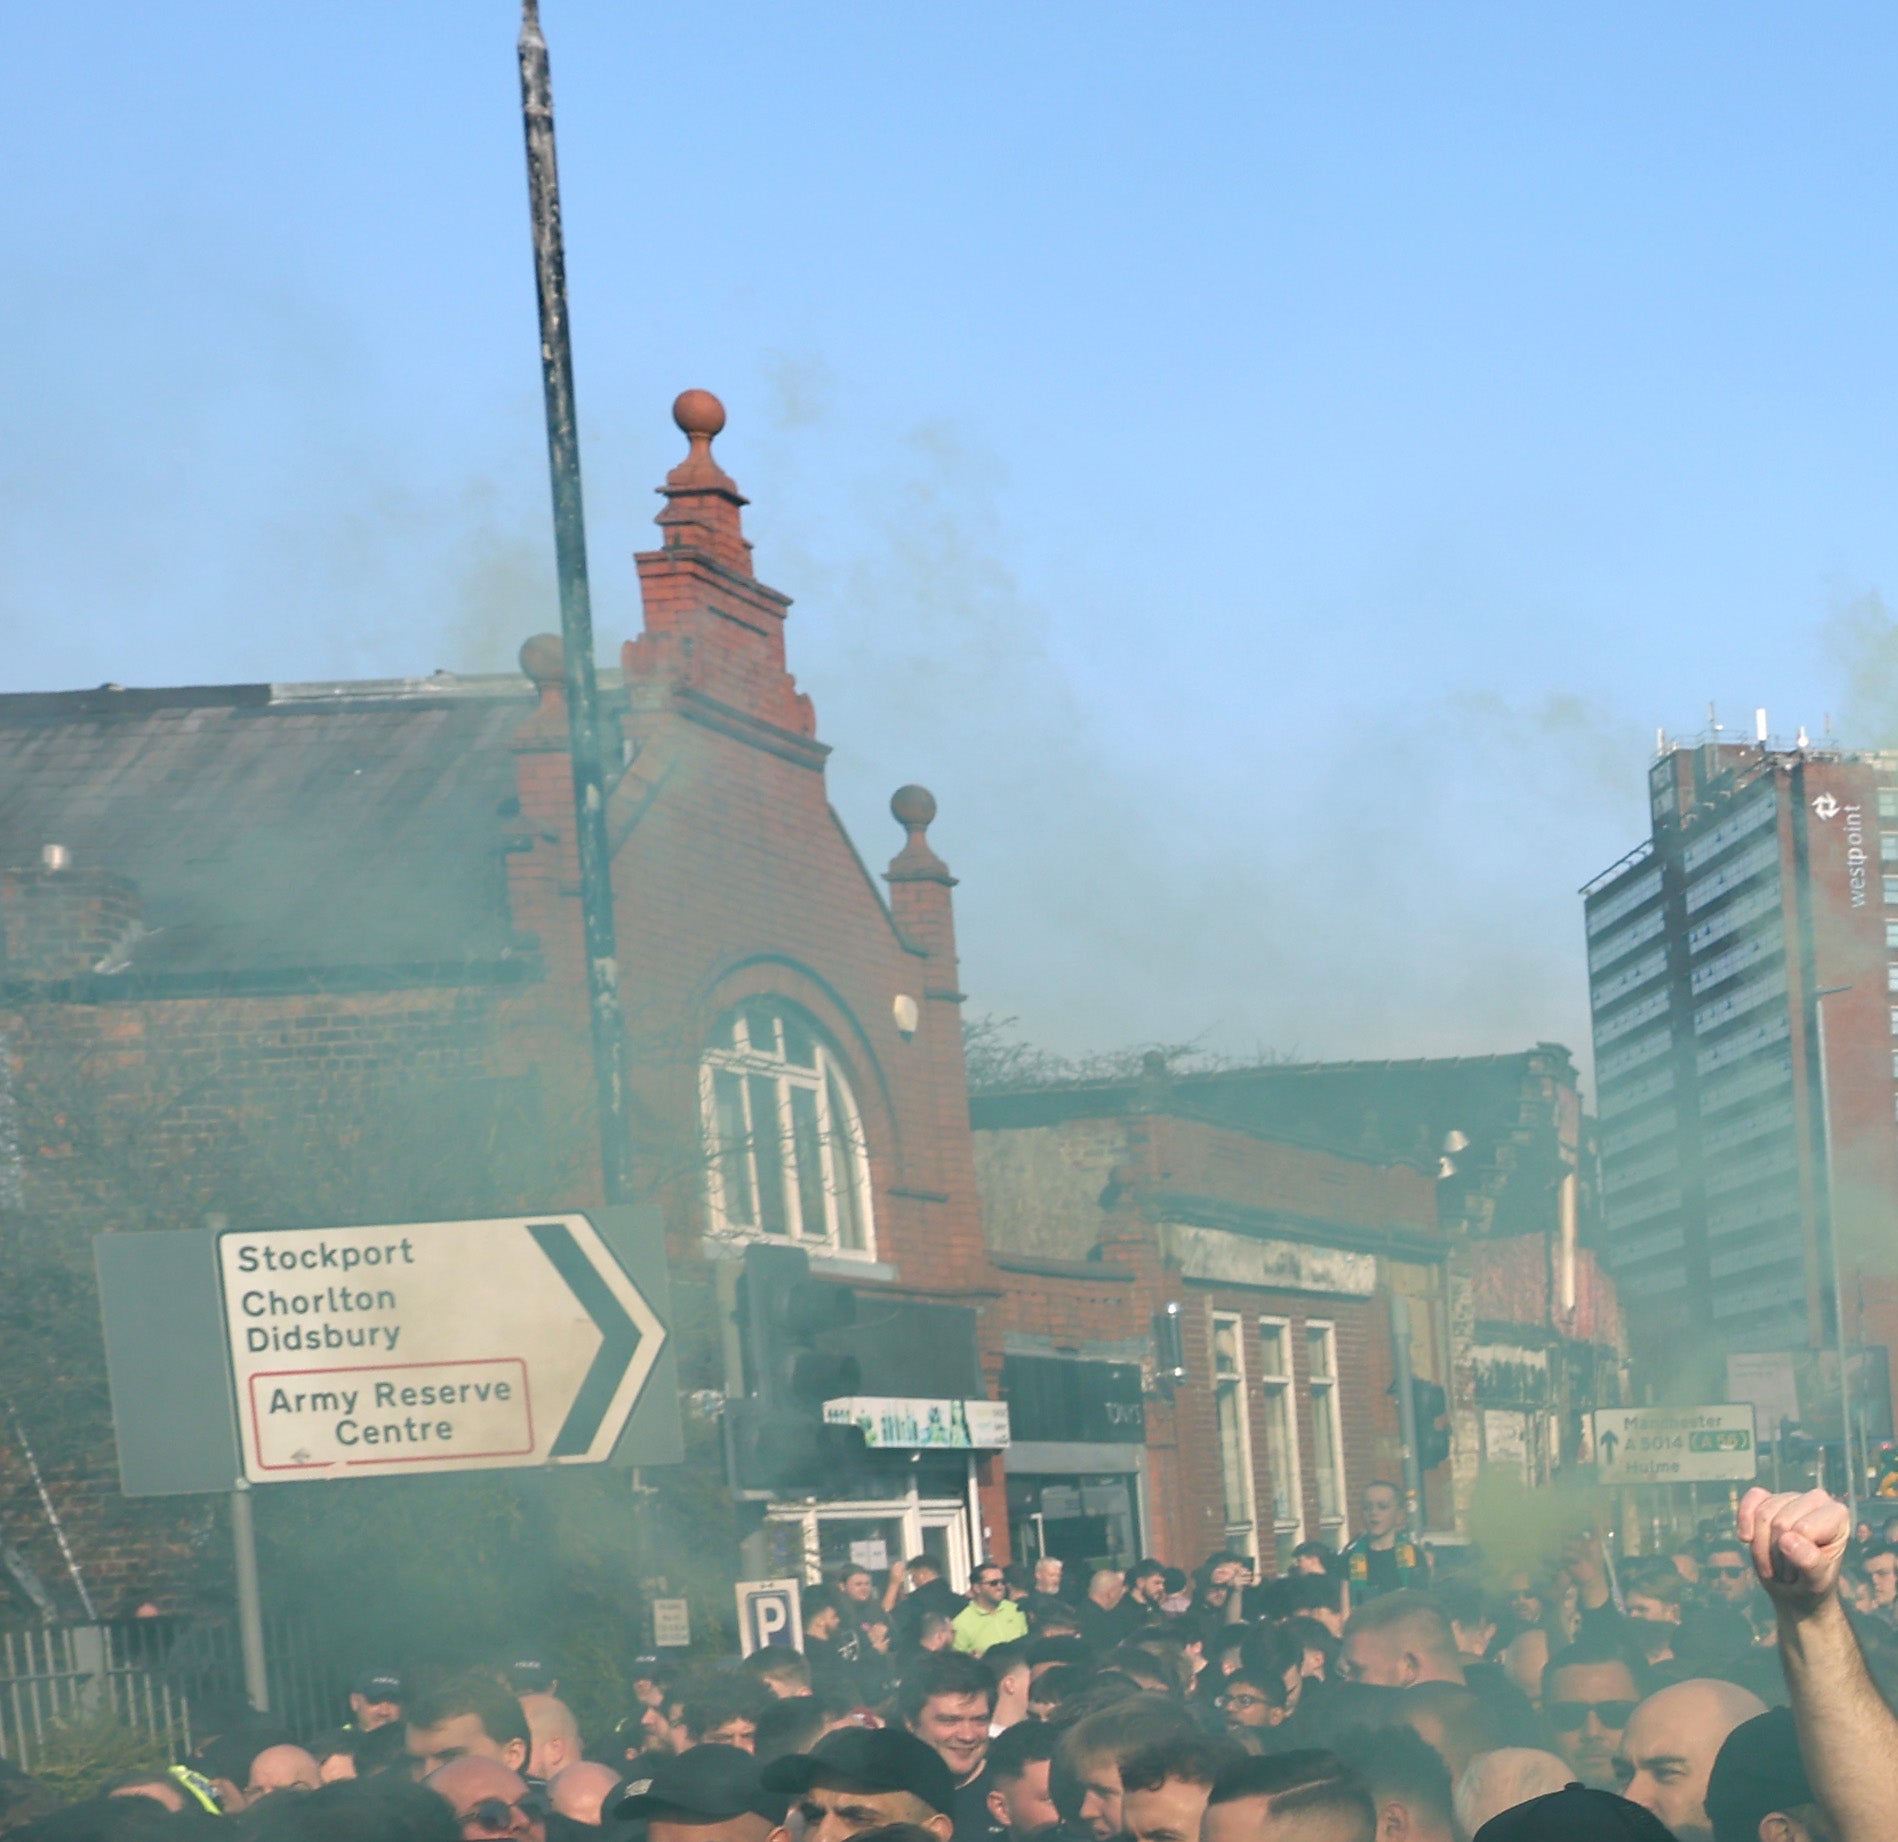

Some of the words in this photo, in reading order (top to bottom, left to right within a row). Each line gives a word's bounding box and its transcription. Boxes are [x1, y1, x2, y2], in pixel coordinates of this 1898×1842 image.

[1843, 806, 1867, 908] westpoint
[238, 1238, 415, 1272] Stockport
[242, 1287, 396, 1317] Chorlton
[247, 1324, 401, 1353] Didsbury
[269, 1388, 358, 1415] Army
[374, 1381, 512, 1407] Reserve
[335, 1417, 453, 1446] Centre
[1624, 1415, 1722, 1430] Manchester
[1626, 1461, 1681, 1474] Hulme
[756, 1597, 787, 1650] P
